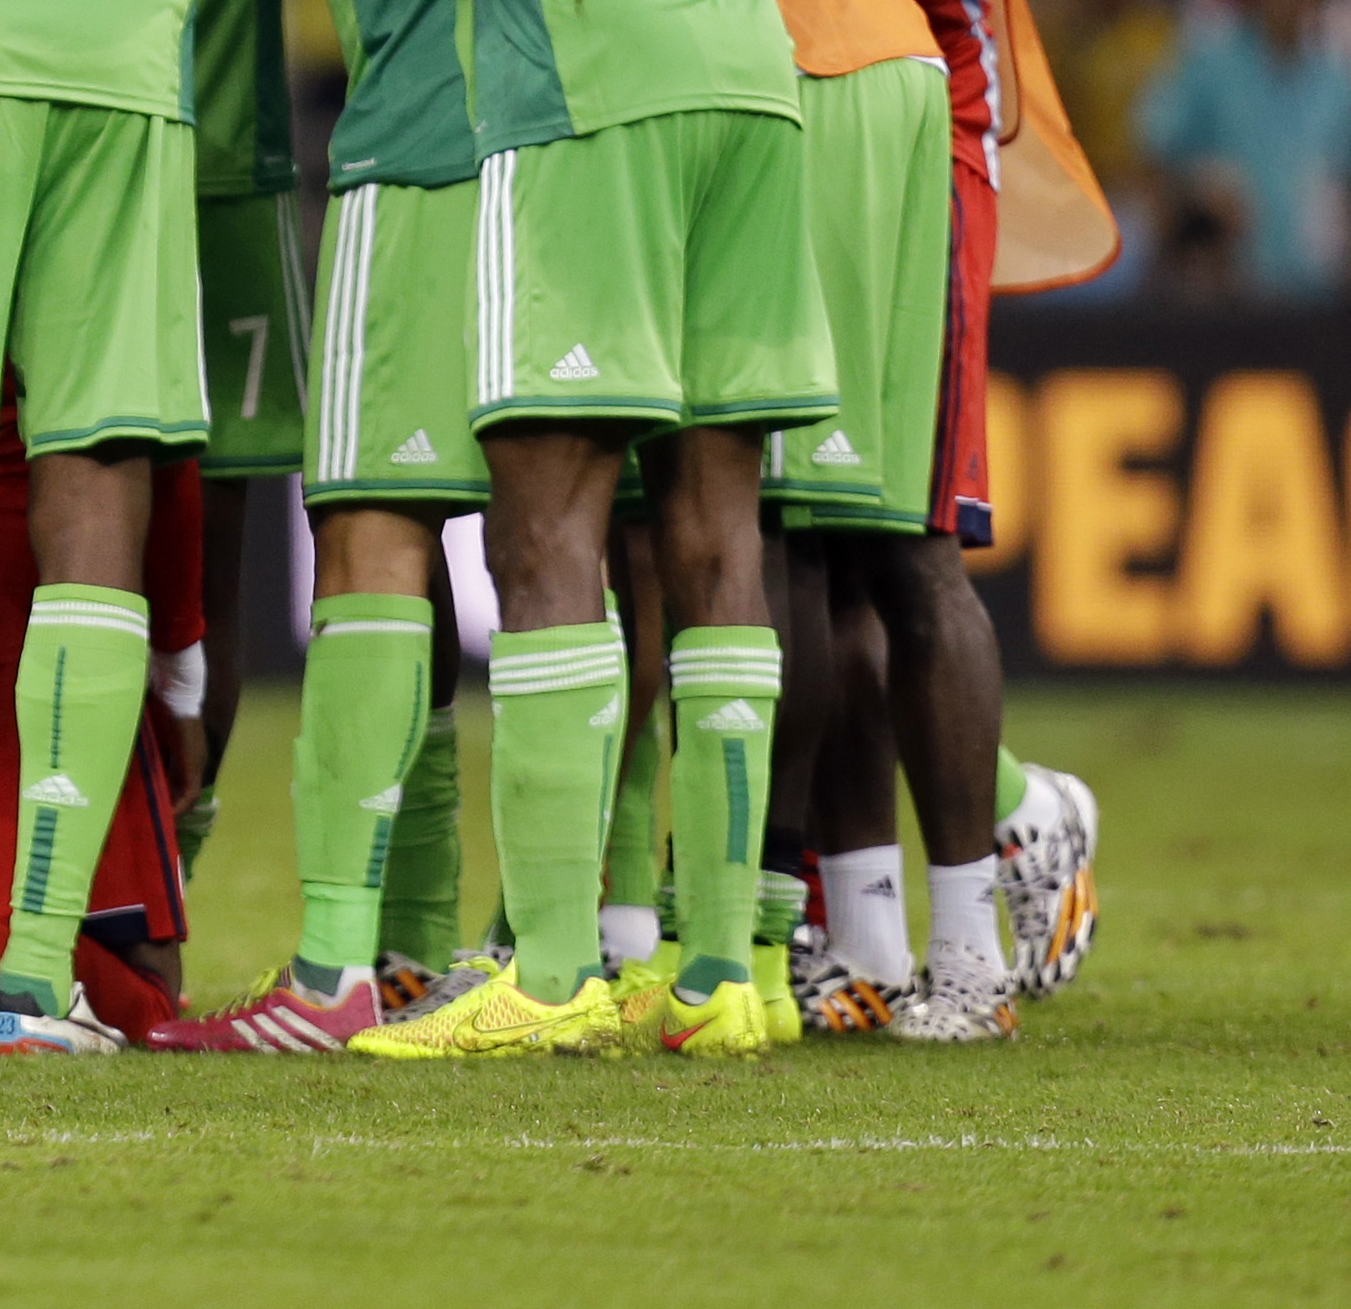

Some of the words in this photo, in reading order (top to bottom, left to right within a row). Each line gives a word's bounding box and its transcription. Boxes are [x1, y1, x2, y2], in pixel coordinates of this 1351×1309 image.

[228, 314, 269, 420] 7
[549, 366, 599, 380] adidas
[390, 451, 438, 464] adidas
